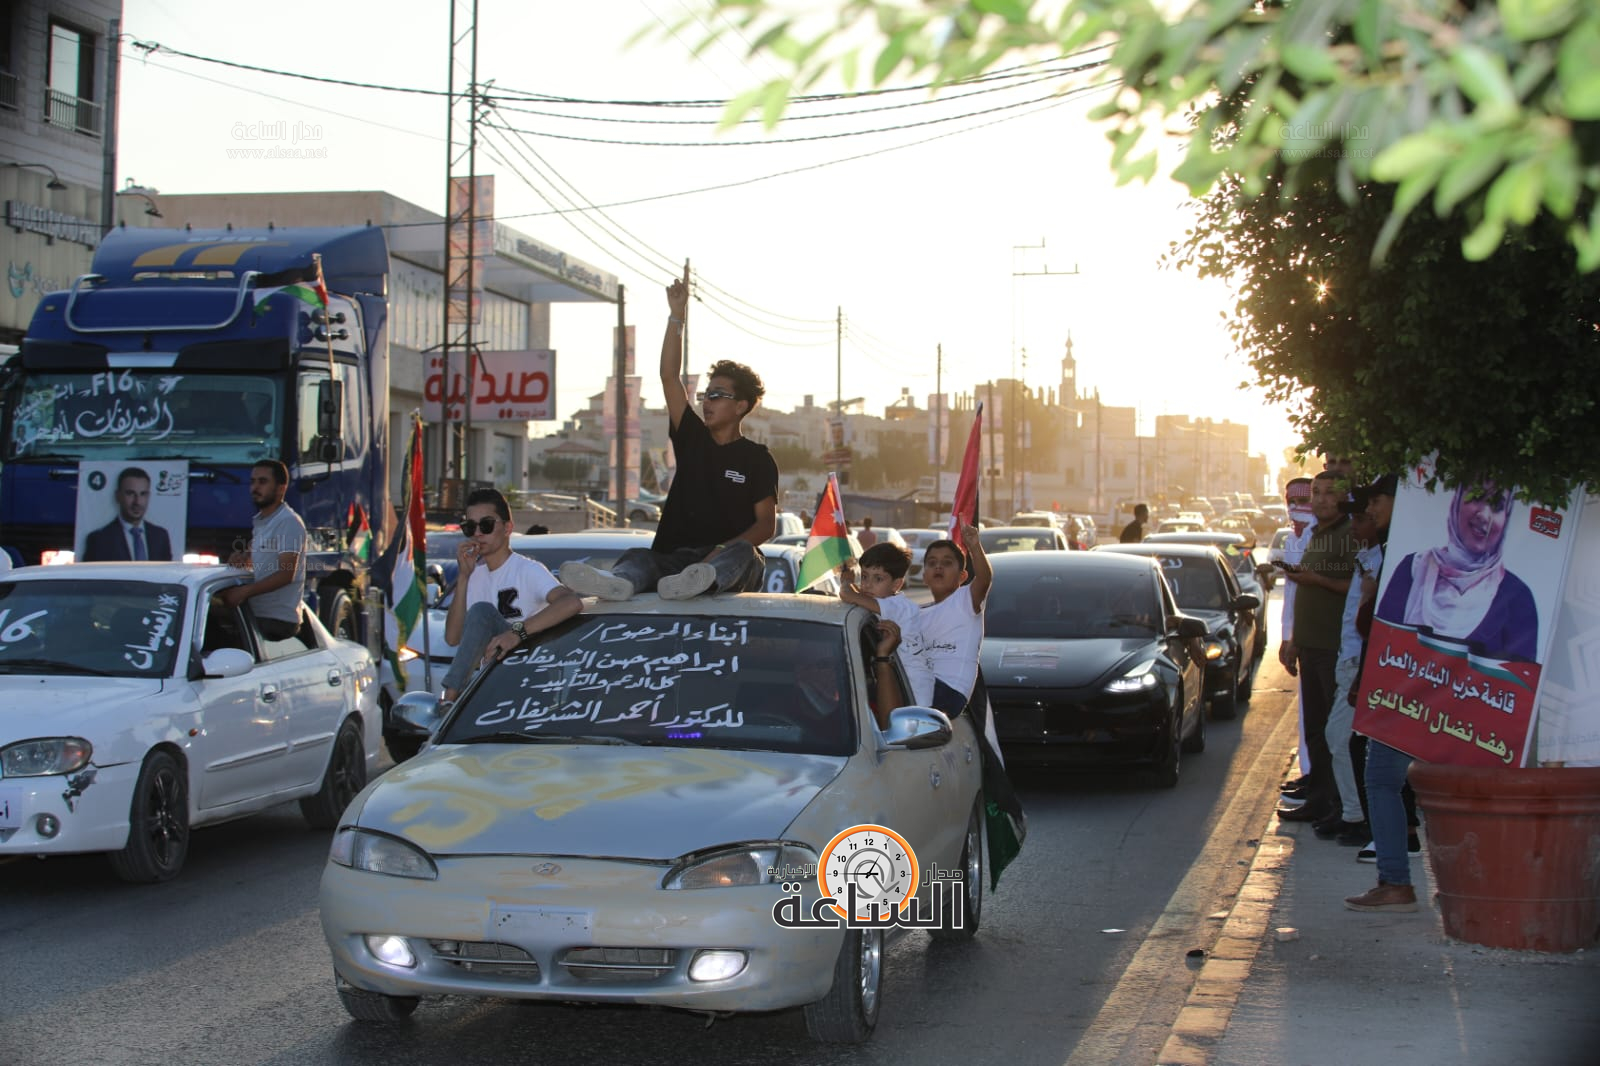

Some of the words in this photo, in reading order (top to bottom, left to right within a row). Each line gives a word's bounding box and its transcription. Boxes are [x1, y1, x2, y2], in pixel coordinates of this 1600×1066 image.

[92, 369, 133, 397] F16
[424, 354, 549, 419] صيدلية
[1379, 645, 1417, 678] والعمل
[1418, 660, 1450, 688] البناء
[605, 674, 651, 695] الدعم
[650, 674, 682, 691] كل
[1452, 676, 1479, 700] حزب
[1481, 681, 1515, 714] قائمة
[594, 694, 665, 724] أحمد
[648, 703, 744, 728] للدكتور
[1367, 688, 1431, 722] الخالدي
[1429, 711, 1473, 742] نضال
[1475, 732, 1514, 764] رهف
